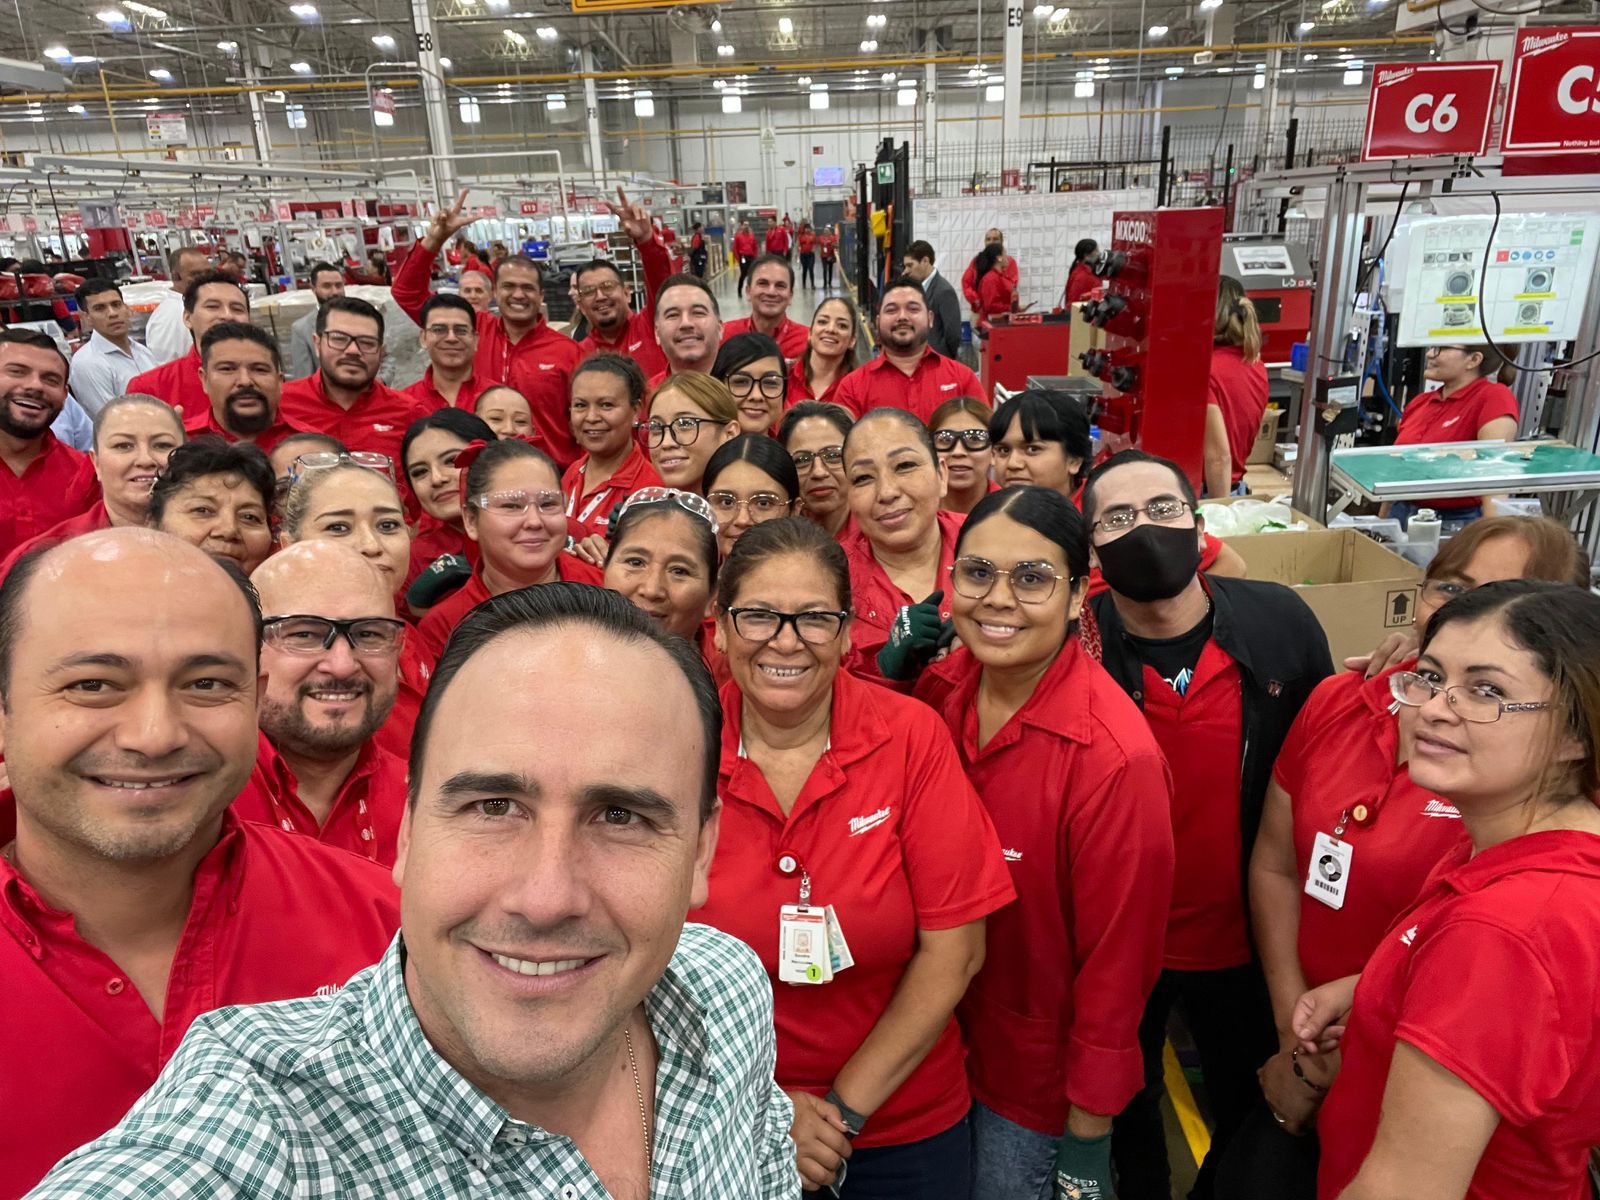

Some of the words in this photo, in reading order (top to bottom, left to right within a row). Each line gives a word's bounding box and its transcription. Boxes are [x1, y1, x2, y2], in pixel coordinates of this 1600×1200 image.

[1008, 7, 1023, 27] E9
[416, 32, 433, 52] E8
[1521, 32, 1569, 52] Milwaukee
[1377, 66, 1415, 84] Milwaukee
[1557, 64, 1600, 115] C
[1404, 92, 1459, 134] C6
[1563, 140, 1588, 148] Nothing
[1392, 616, 1407, 624] UP
[848, 806, 891, 832] Milwaukee
[811, 968, 816, 978] 1
